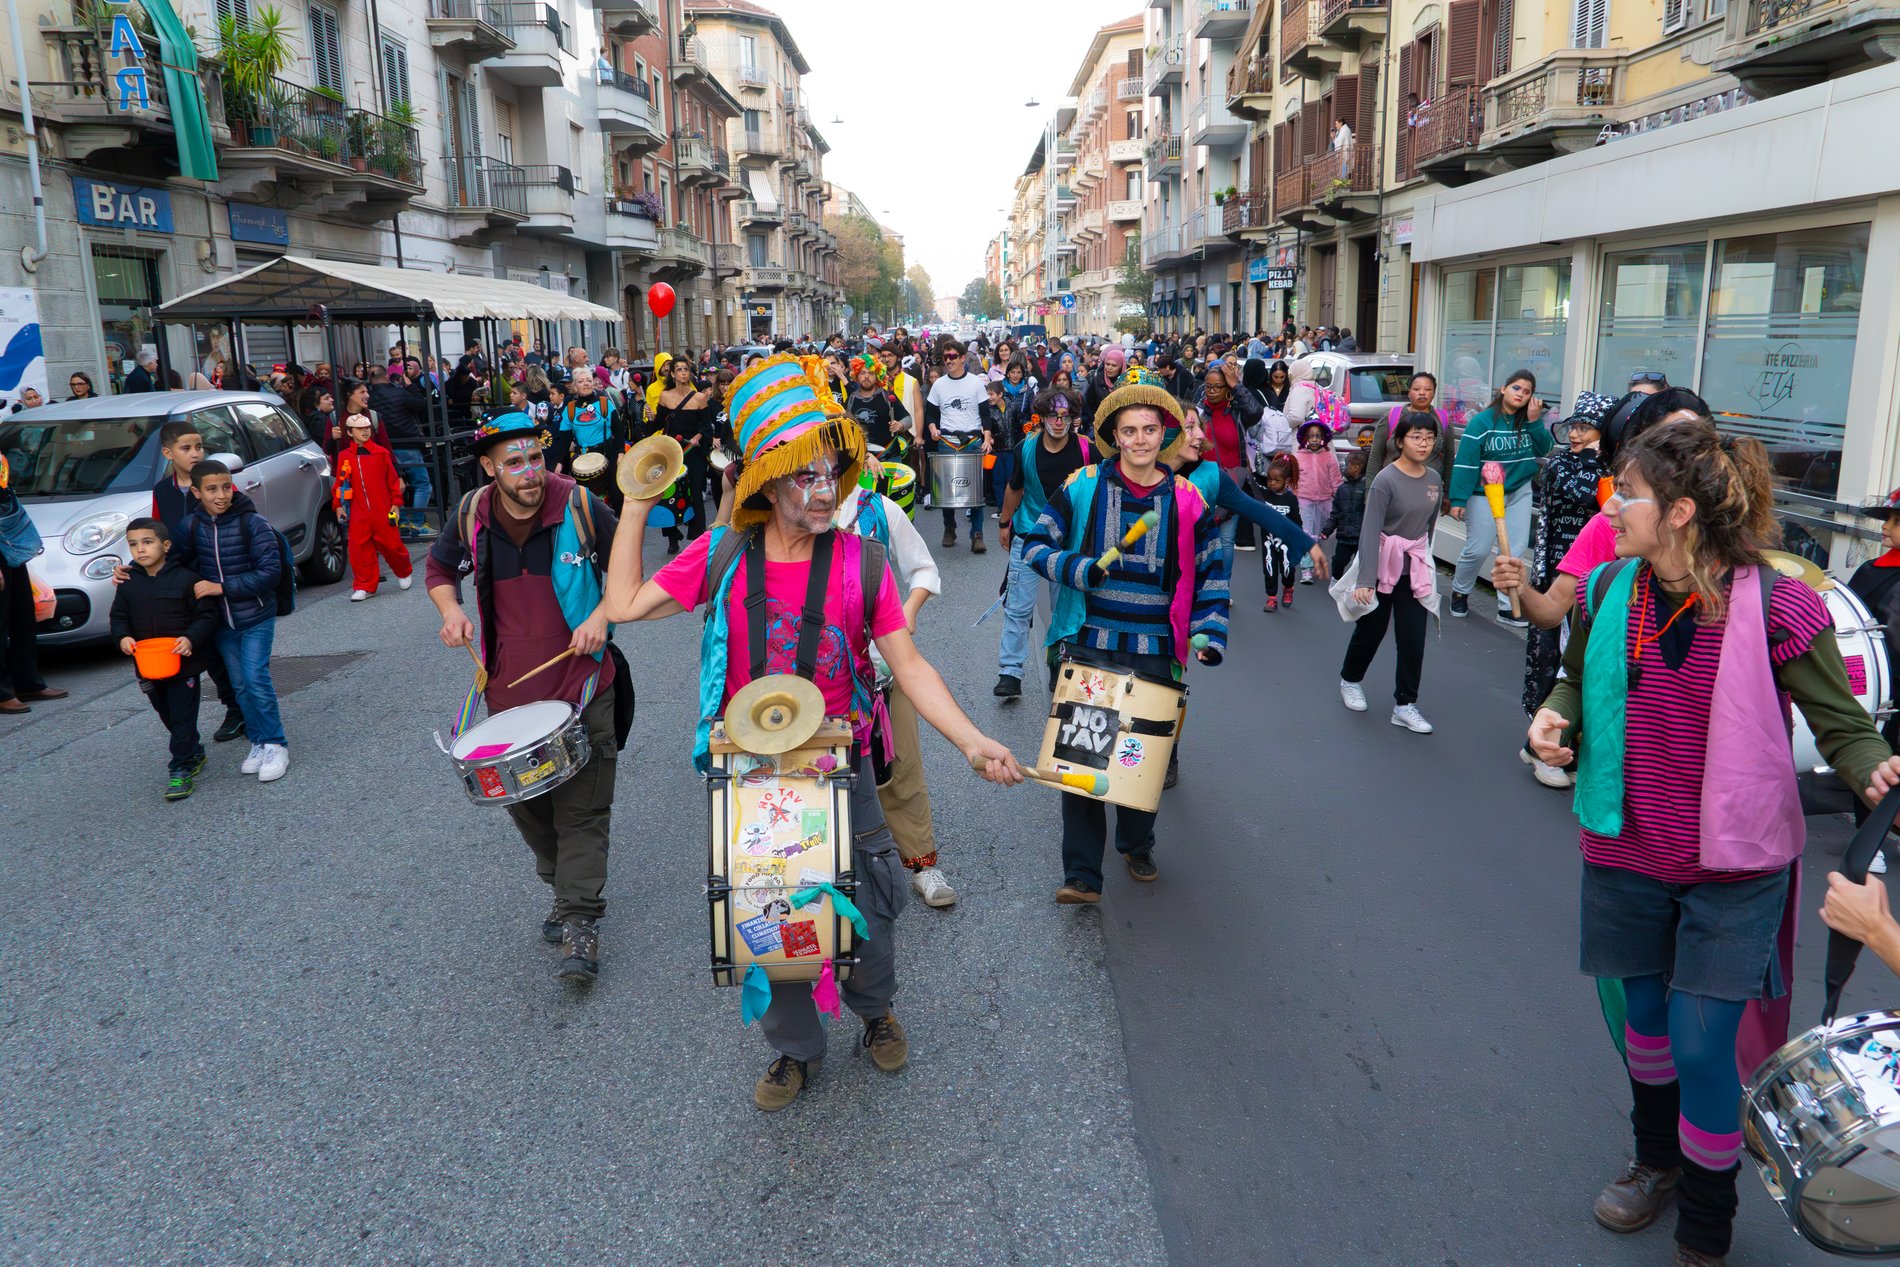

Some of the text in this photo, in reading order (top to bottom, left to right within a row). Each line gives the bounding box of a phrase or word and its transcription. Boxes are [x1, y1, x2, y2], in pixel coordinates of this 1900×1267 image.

[90, 184, 159, 227] BAR
[1269, 270, 1293, 280] PIZZA
[1269, 280, 1294, 289] KEBAB
[1781, 354, 1818, 368] PIZZERIA
[1073, 706, 1107, 733] NO
[1062, 724, 1112, 753] TAV
[758, 787, 803, 810] NO TAV
[745, 872, 760, 886] FOOD
